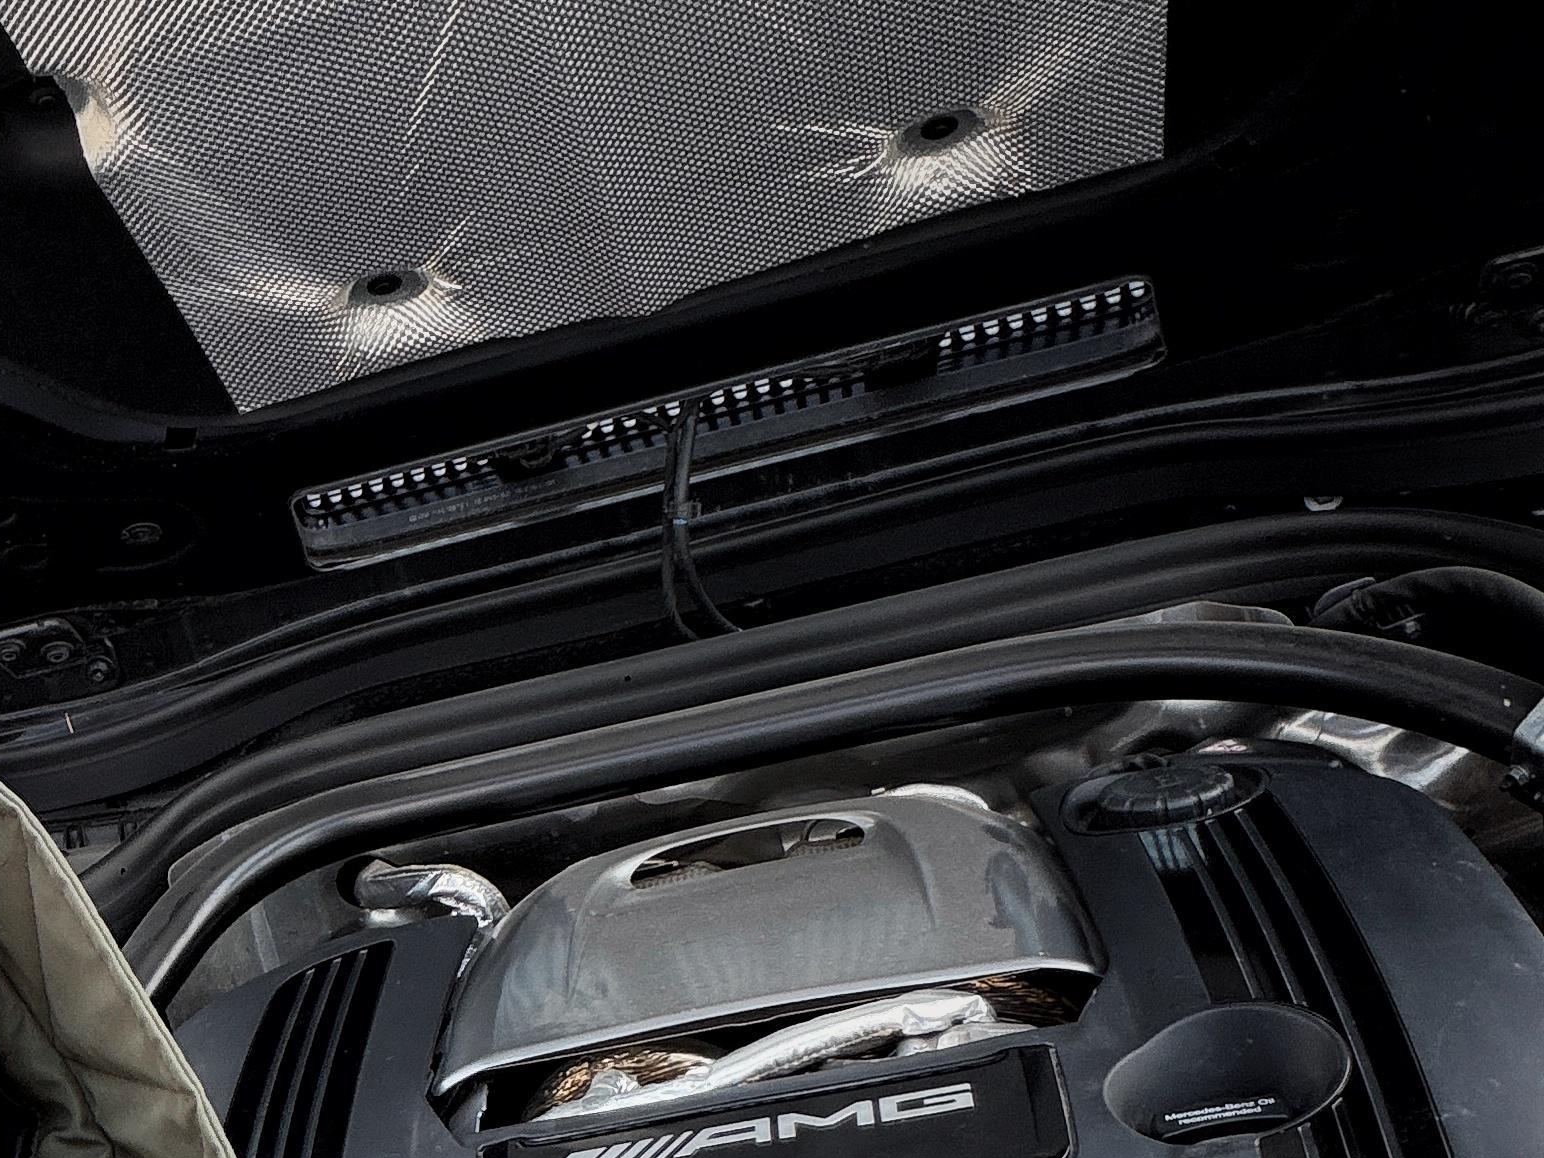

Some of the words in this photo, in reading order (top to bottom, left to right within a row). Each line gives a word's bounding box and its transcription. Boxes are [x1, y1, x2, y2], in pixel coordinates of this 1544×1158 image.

[675, 1083, 977, 1157] AMG
[1164, 1101, 1255, 1121] Mercedes-Benz
[1178, 1105, 1262, 1125] recommended
